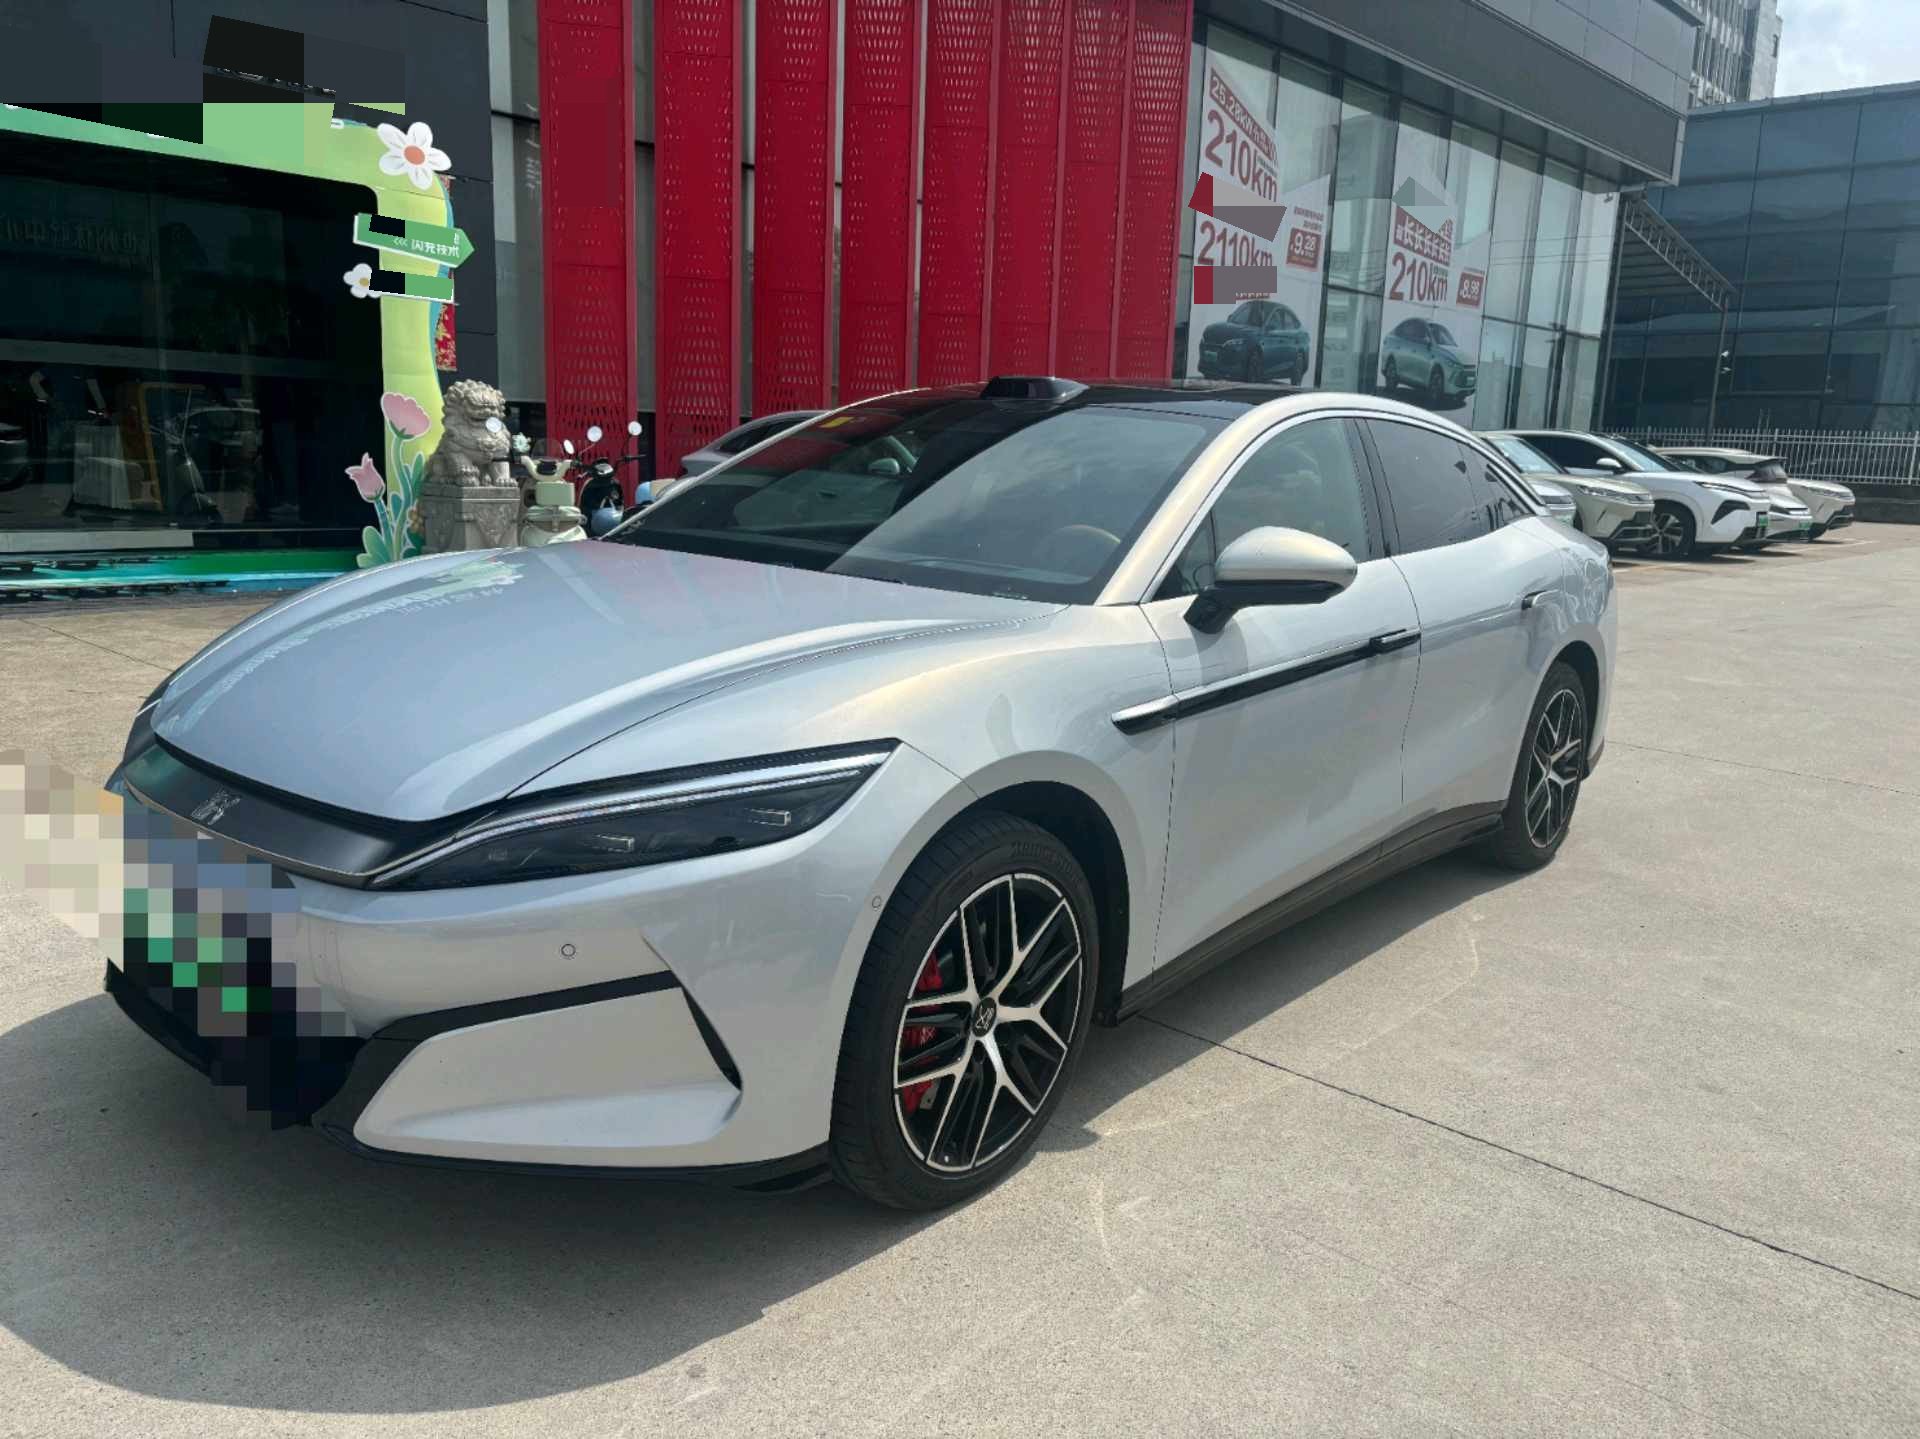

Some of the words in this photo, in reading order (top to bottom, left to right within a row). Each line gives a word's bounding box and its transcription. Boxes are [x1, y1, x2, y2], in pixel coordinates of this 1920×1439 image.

[1205, 109, 1277, 203] 210km
[411, 238, 459, 258] 闪充技术
[1197, 220, 1273, 266] 2110km
[1390, 251, 1448, 301] 210km
